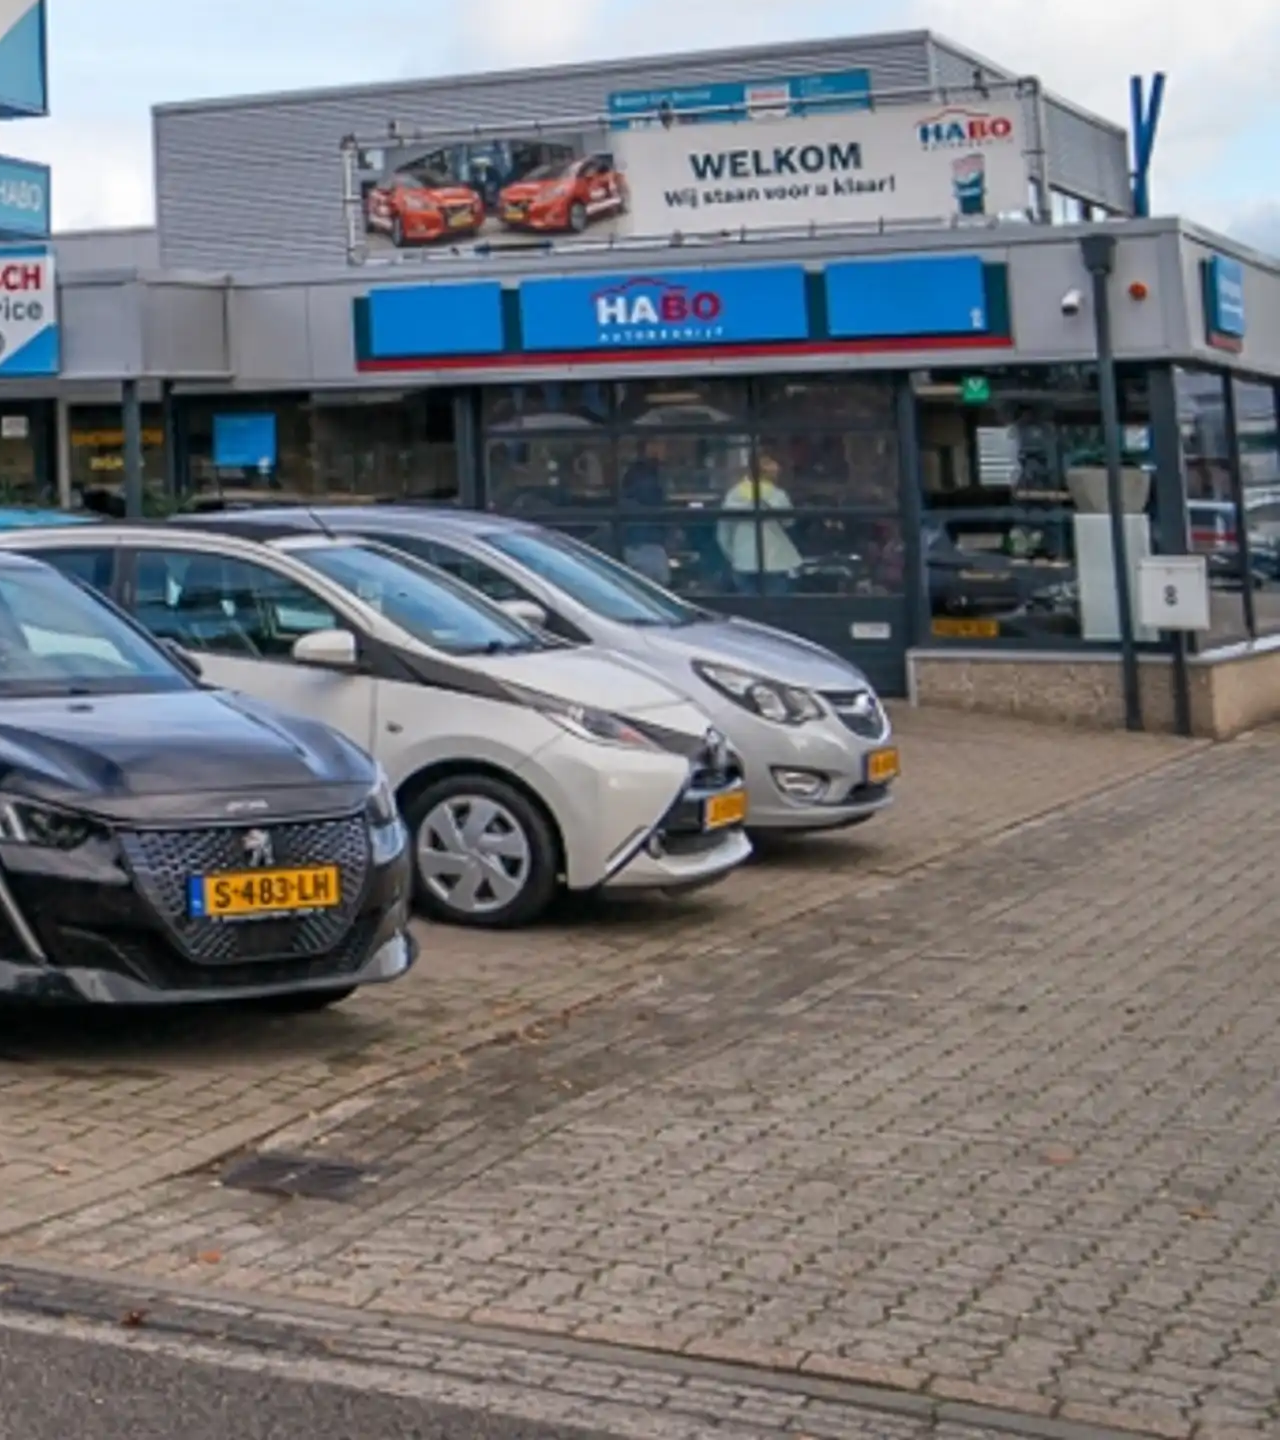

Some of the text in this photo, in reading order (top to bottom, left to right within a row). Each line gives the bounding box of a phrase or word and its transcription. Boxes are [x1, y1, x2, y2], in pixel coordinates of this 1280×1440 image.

[918, 116, 1013, 143] HABO
[689, 142, 863, 181] WELKOM
[664, 189, 698, 209] Wij
[702, 186, 760, 205] staan
[762, 183, 811, 201] voor
[813, 183, 829, 197] u
[597, 291, 721, 326] HABO
[214, 872, 330, 909] S-483-LH
